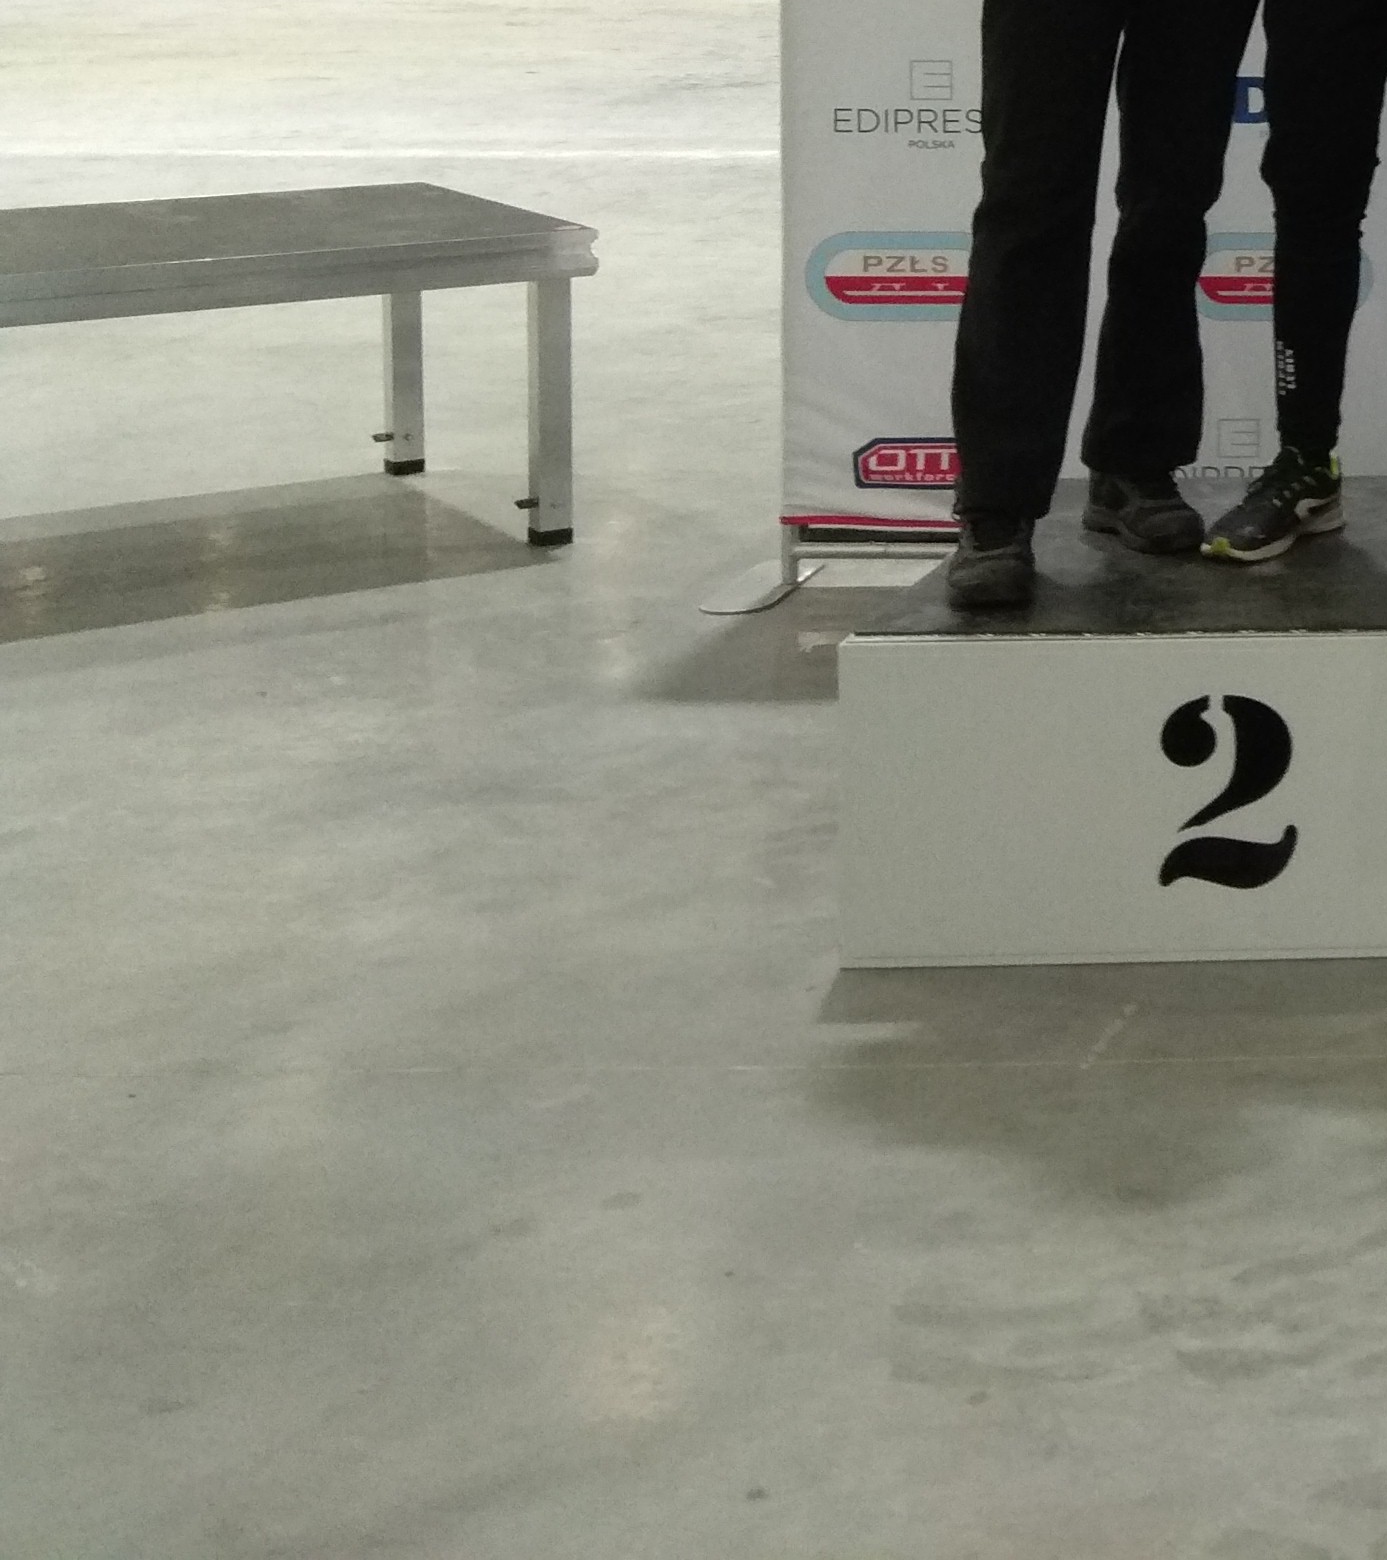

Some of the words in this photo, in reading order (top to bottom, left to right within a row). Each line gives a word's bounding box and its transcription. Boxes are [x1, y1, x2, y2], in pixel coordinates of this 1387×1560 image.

[834, 108, 982, 134] EDIPRES
[908, 139, 955, 149] POLSKA
[863, 255, 949, 273] PZŁS
[1235, 256, 1274, 273] PZ
[868, 448, 957, 471] OTT
[1159, 694, 1298, 889] 2
